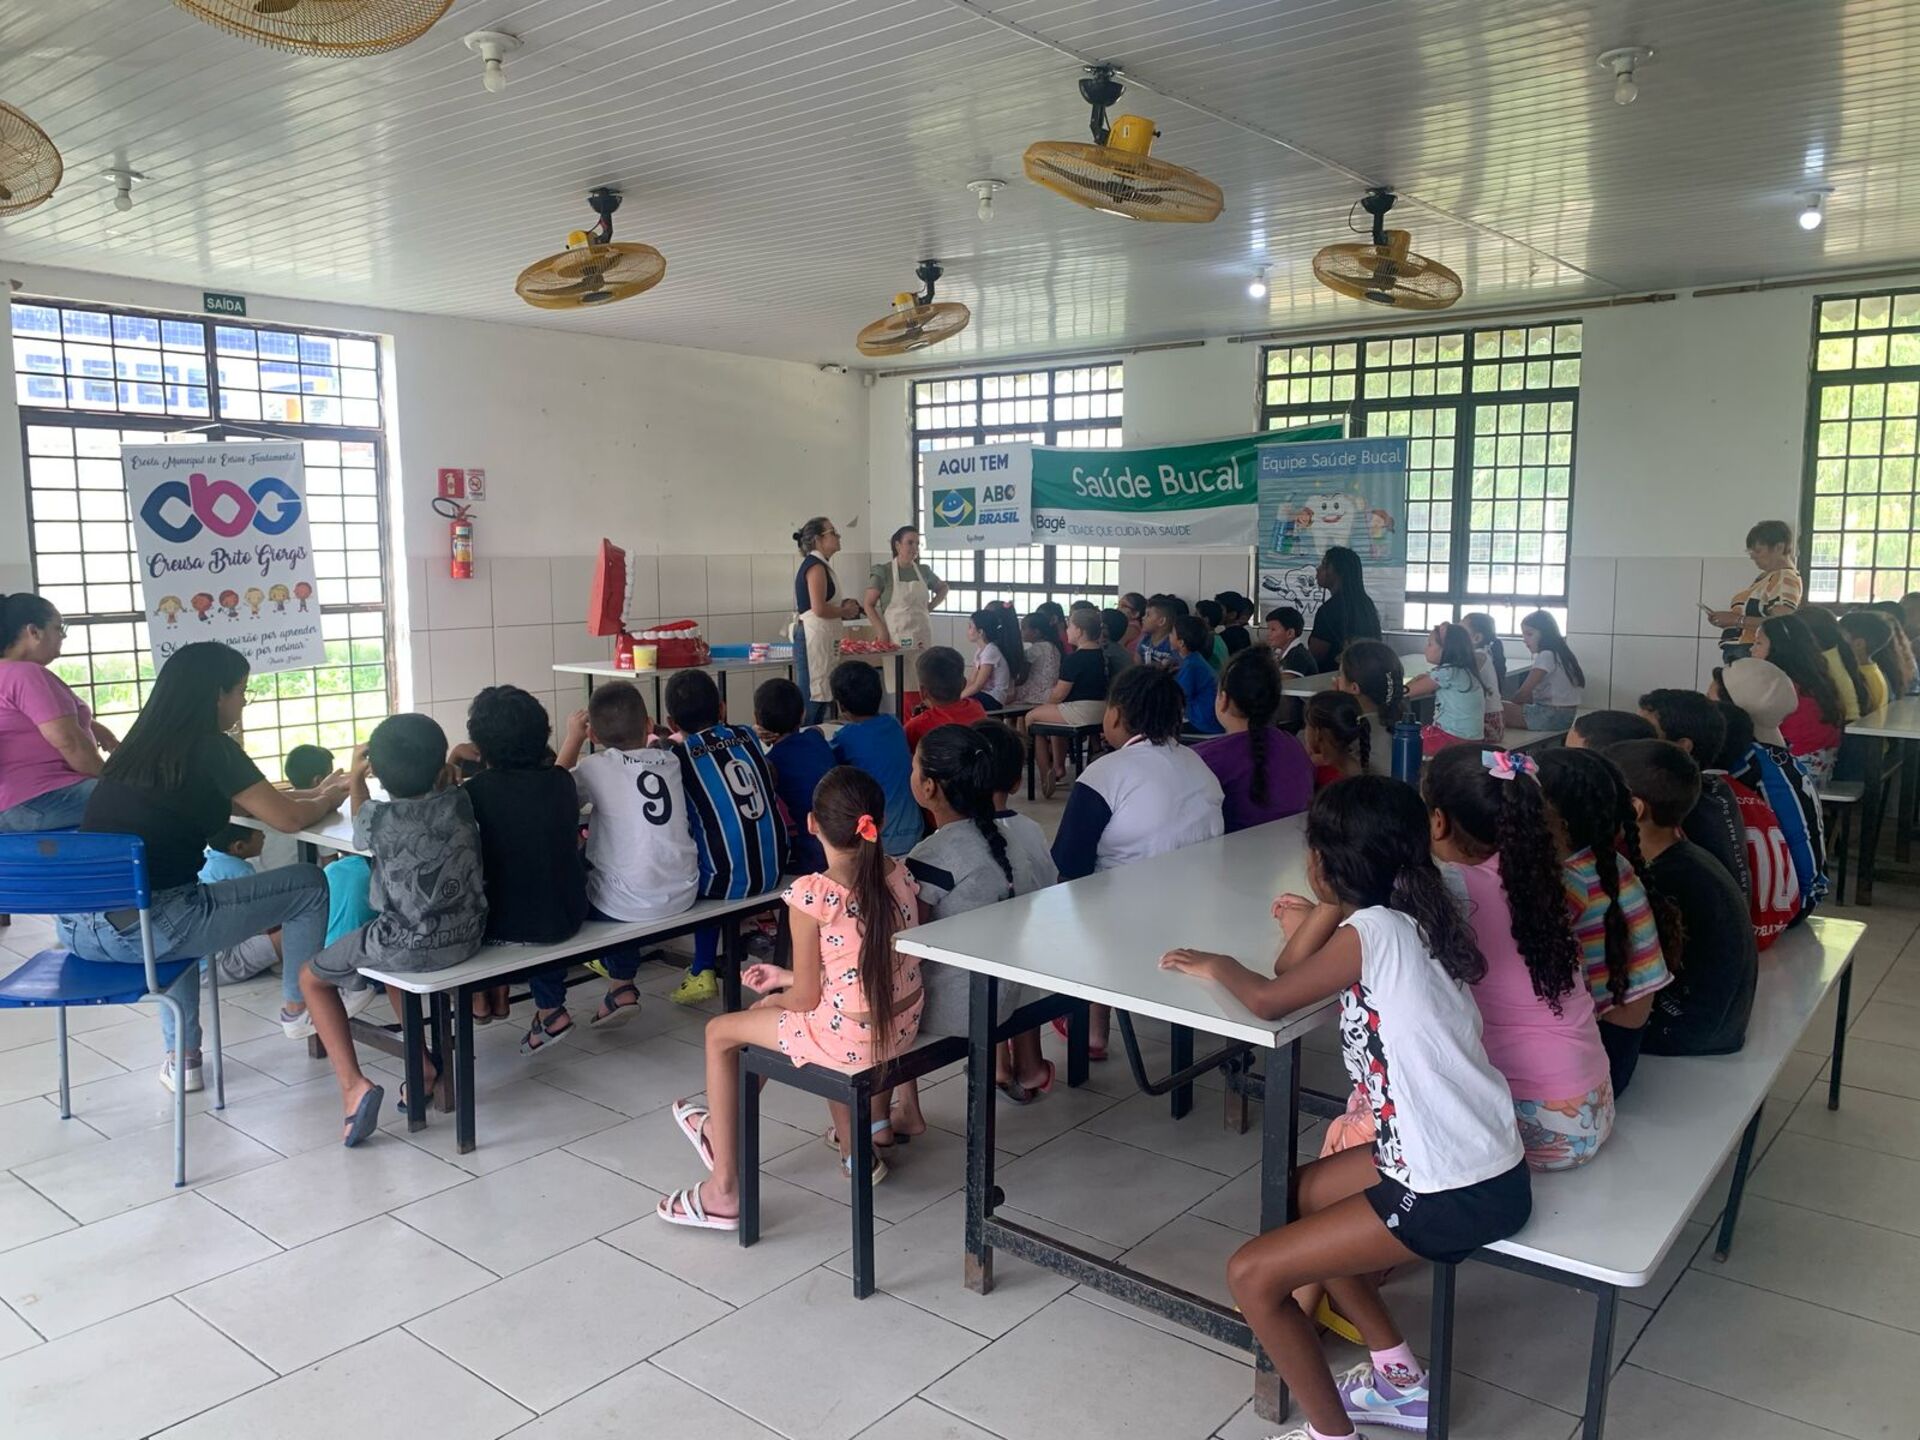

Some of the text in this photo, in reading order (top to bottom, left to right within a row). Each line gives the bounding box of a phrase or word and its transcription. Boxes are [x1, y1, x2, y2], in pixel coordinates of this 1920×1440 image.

[207, 297, 243, 312] SAÍDA
[938, 453, 1009, 475] AQUI TEM
[1262, 448, 1401, 473] Equipe Saúde Bucal
[1072, 456, 1244, 499] Saúde Bucal
[978, 511, 1020, 525] BRASIL
[1036, 514, 1192, 537] Bagé CIDADE QUE CUIDA DA SAÚDE
[146, 544, 308, 579] Creusa Brito Giorgis
[260, 630, 277, 646] por
[279, 625, 317, 642] aprender
[256, 646, 271, 661] por
[636, 769, 673, 826] 9
[724, 759, 765, 820] 9
[1399, 1191, 1417, 1212] LOV
